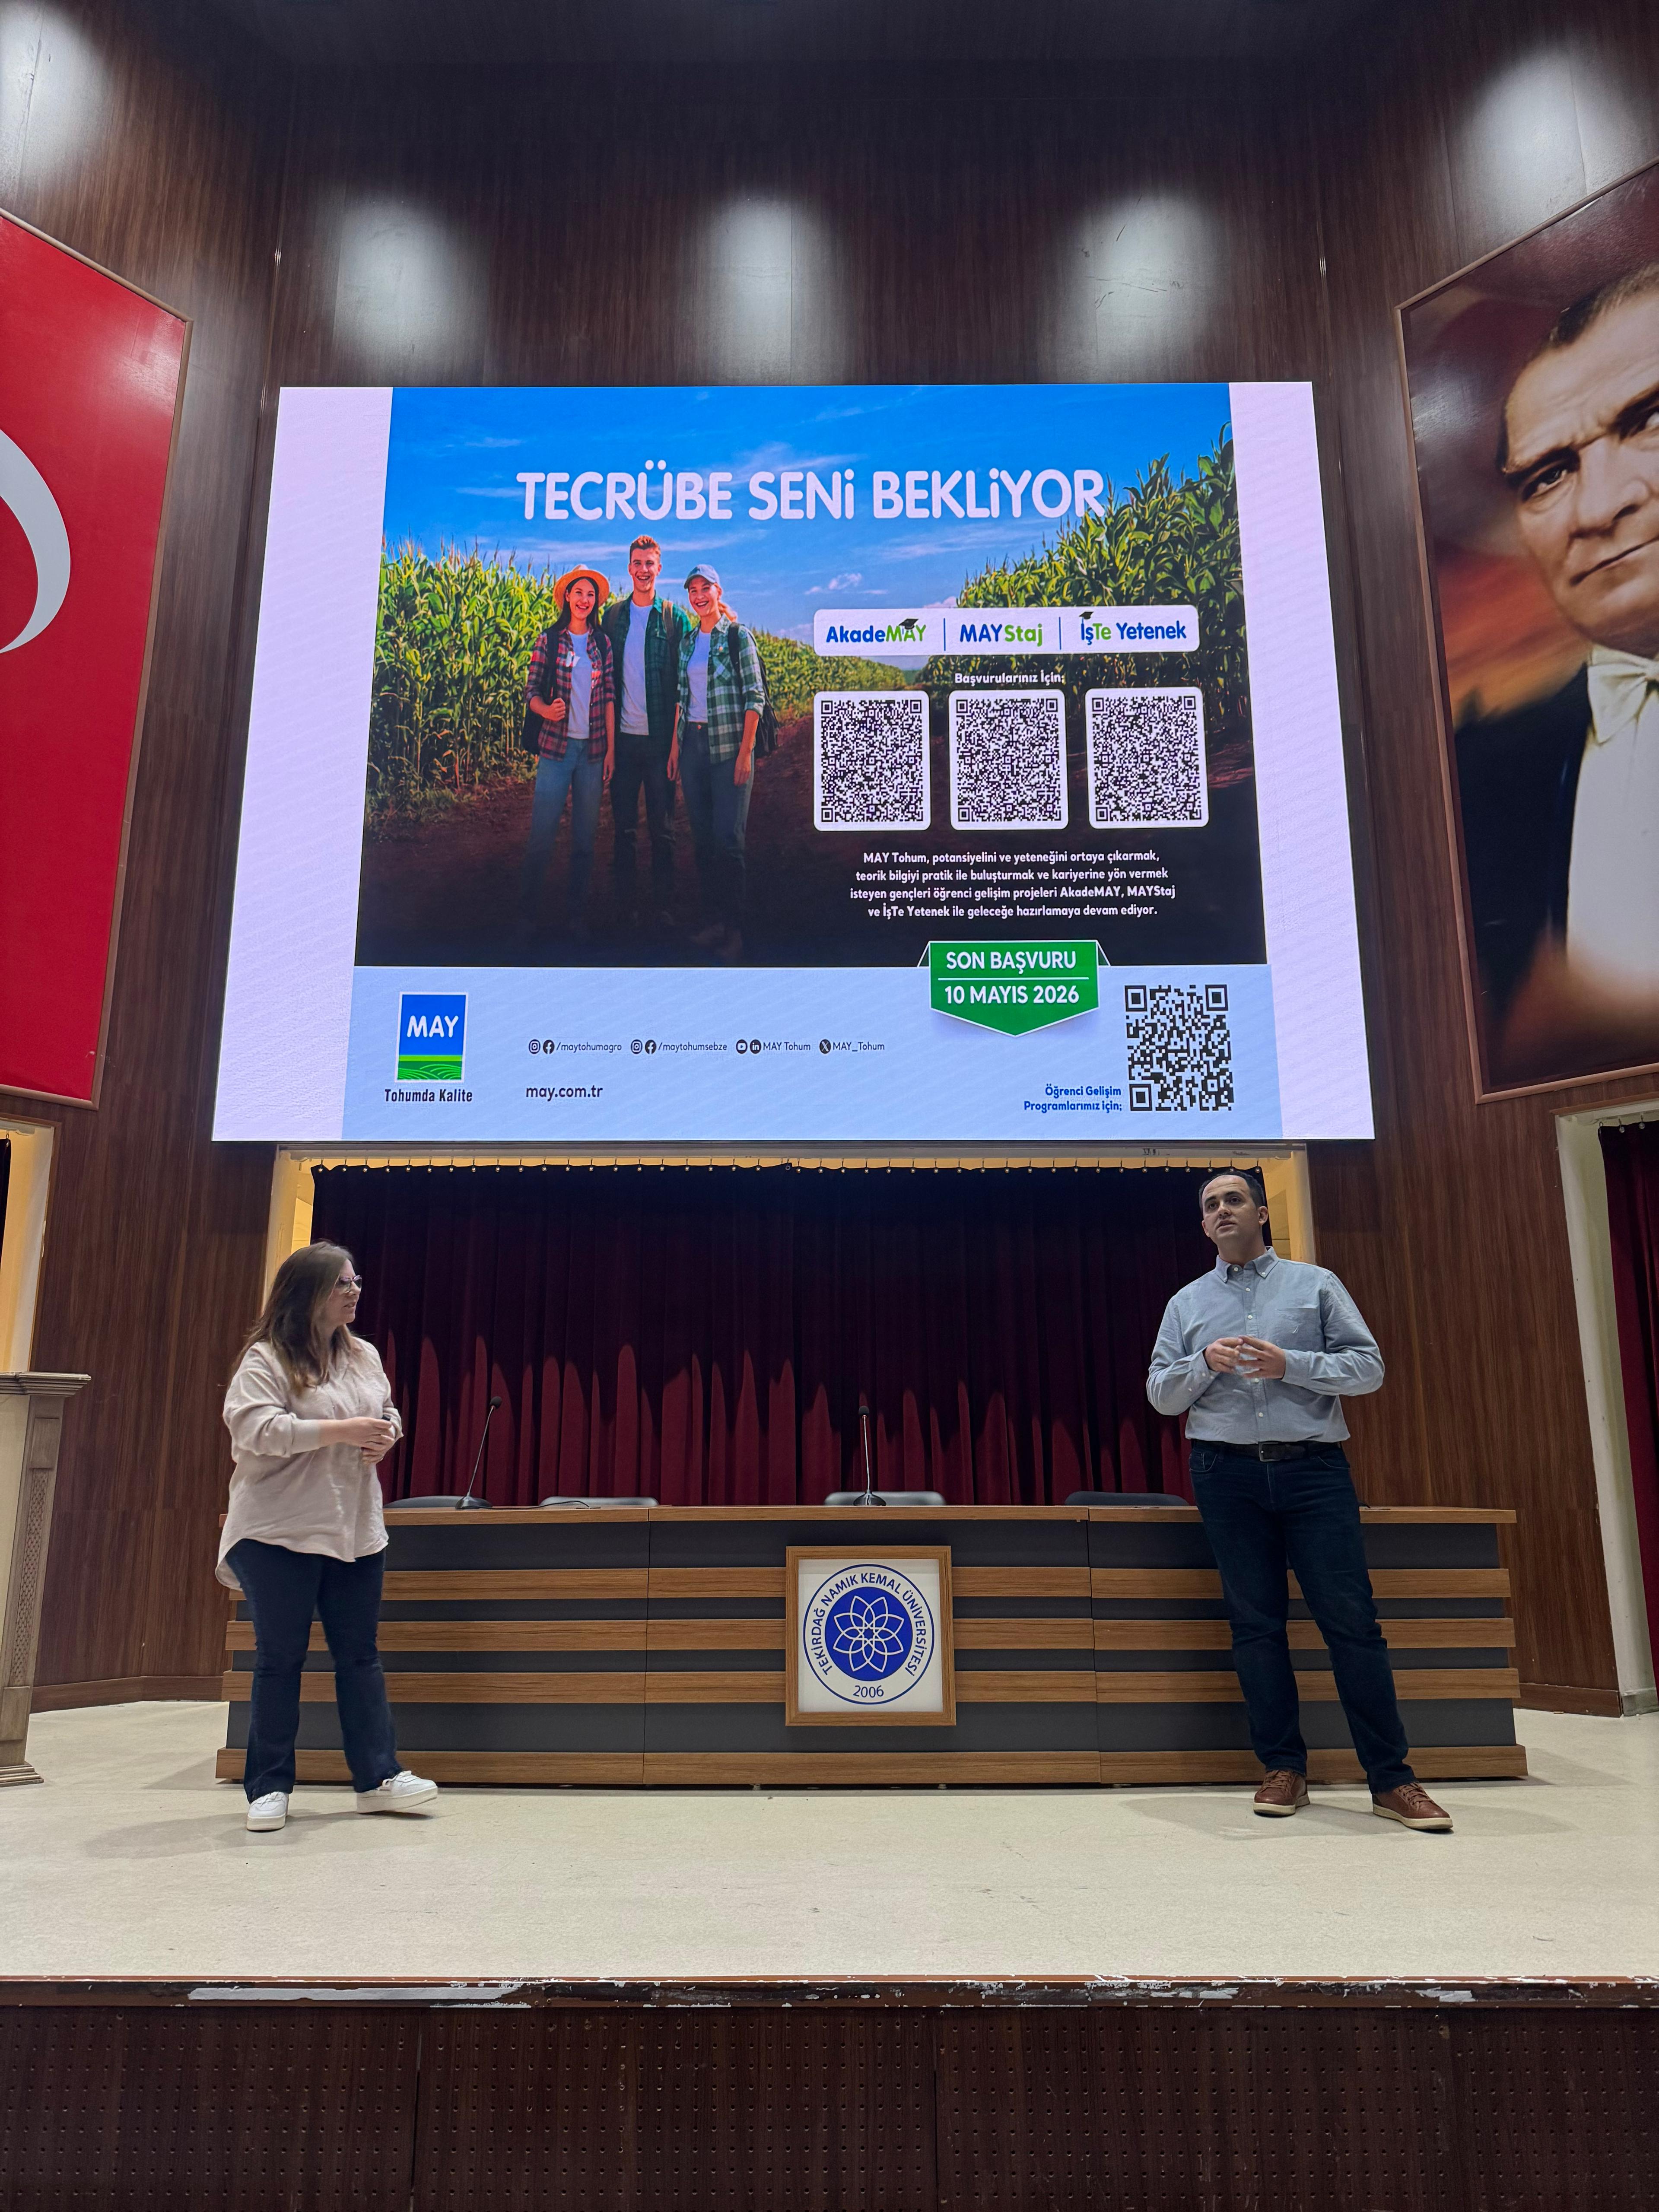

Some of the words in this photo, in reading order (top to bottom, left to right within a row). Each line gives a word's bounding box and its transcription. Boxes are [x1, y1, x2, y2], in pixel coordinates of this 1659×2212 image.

[517, 460, 732, 519] TECRÜBE
[826, 624, 926, 643] AkadeMAY
[1116, 620, 1186, 639] Yetenek
[954, 672, 1038, 686] Başvurularınız
[864, 852, 890, 863] MAY
[892, 852, 929, 864] Tohum,
[933, 852, 996, 865] potansiyelini
[1014, 851, 1067, 864] yeteneğini
[1071, 852, 1104, 864] ortaya
[1107, 850, 1160, 864] çıkarmak,
[856, 870, 886, 880] teorik
[890, 870, 919, 883] bilgiyi
[922, 870, 953, 883] pratik
[956, 870, 967, 880] ile
[971, 869, 1034, 883] buluşturmak
[1052, 868, 1105, 882] kariyerine
[1108, 868, 1126, 881] yön
[1129, 867, 1168, 878] vermek
[850, 888, 887, 901] isteyen
[890, 887, 930, 901] gençleri
[934, 887, 972, 901] öğrenci
[975, 887, 1010, 901] gelişim
[1014, 887, 1057, 900] projeleri
[1060, 886, 1124, 898] AkadeMAY,
[1127, 885, 1175, 899] MAYStaj
[884, 903, 904, 919] İşTe
[907, 906, 950, 916] Yetenek
[953, 906, 964, 916] ile
[968, 906, 1013, 919] geleceğe
[1017, 905, 1080, 918] hazırlamaya
[1083, 905, 1118, 915] devam
[1121, 904, 1157, 917] ediyor.
[946, 952, 986, 969] SON
[990, 951, 1076, 974] BAŞVURU
[944, 987, 965, 1004] 10
[970, 986, 1028, 1004] MAYIS
[1033, 985, 1079, 1003] 2026
[407, 1015, 458, 1037] MAY
[763, 1042, 782, 1051] MAY
[784, 1042, 810, 1051] Tohum
[833, 1042, 884, 1052] MAY_Tohum
[385, 1089, 435, 1102] Tohumda
[439, 1089, 473, 1102] Kalite
[526, 1085, 603, 1102] may.com.tr
[1046, 1084, 1083, 1098] Öğrenci
[1086, 1086, 1121, 1098] Gelişim
[1024, 1101, 1100, 1113] Programlarımız
[821, 1574, 858, 1606] NAMIK
[861, 1572, 900, 1594] KEMAL
[902, 1589, 928, 1677] ÜNİVERSİTESİ
[811, 1608, 832, 1675] TEKİRDAĞ
[853, 1685, 884, 1697] 2006
